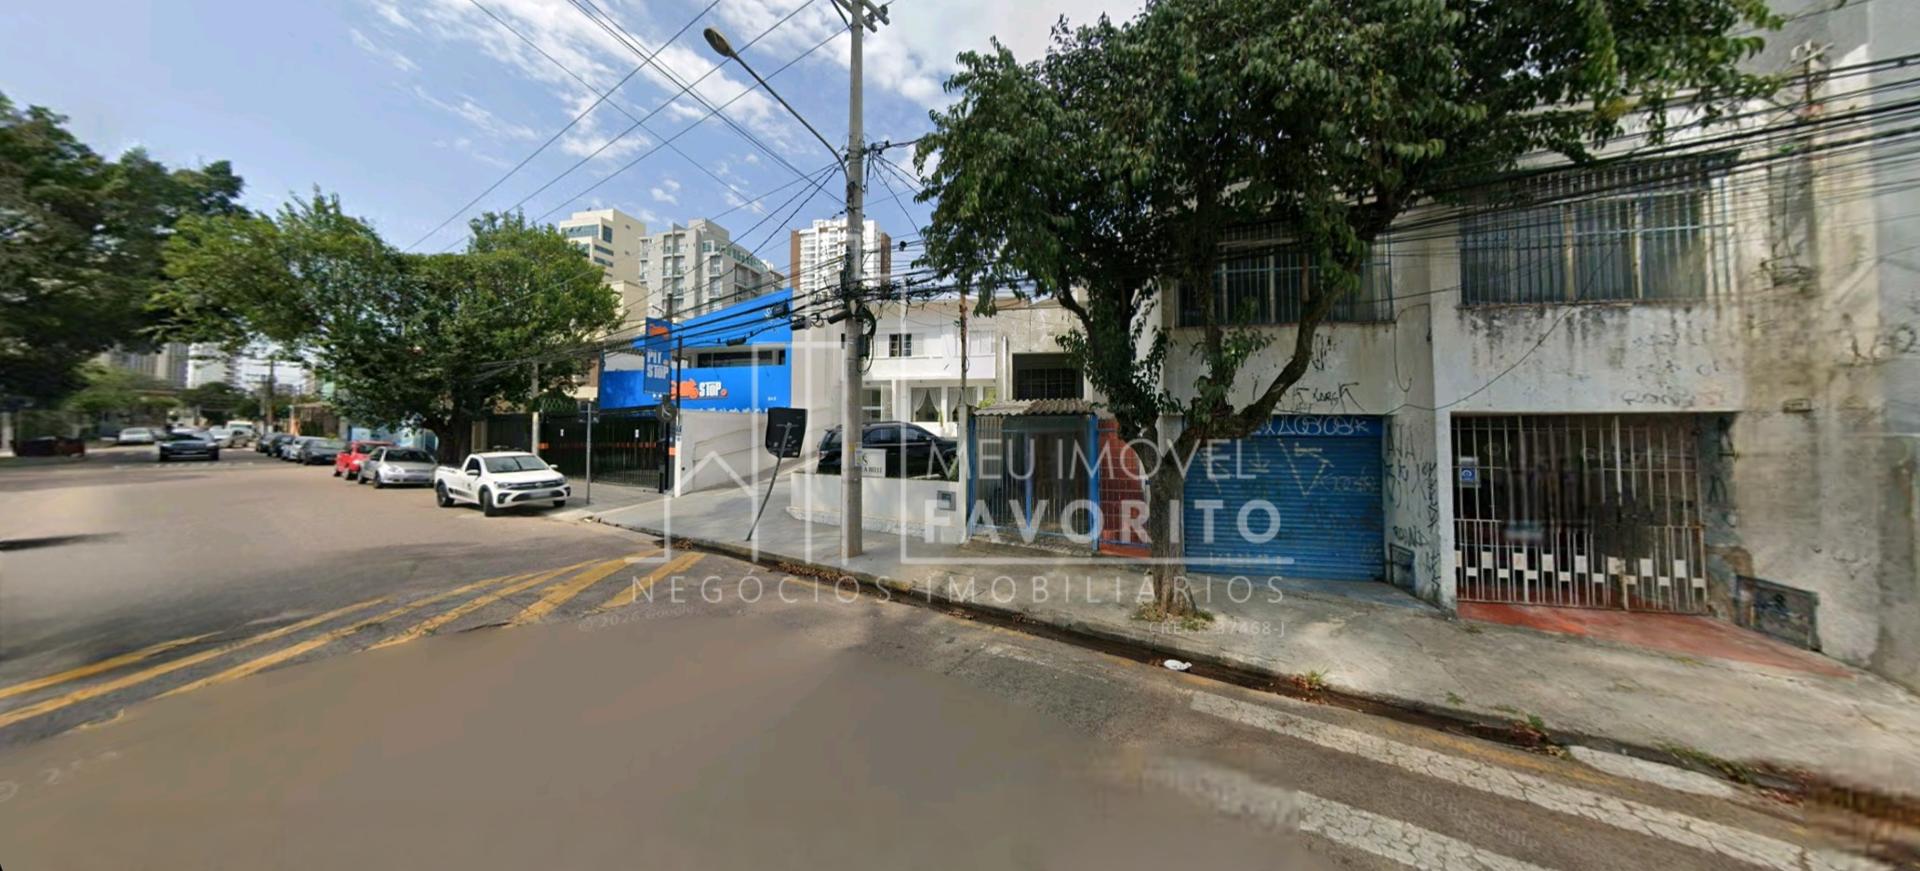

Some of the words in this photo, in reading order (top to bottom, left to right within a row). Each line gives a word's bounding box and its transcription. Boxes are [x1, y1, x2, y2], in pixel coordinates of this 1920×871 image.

[647, 351, 662, 364] PIT
[646, 364, 669, 379] STOP
[699, 381, 722, 397] STOP
